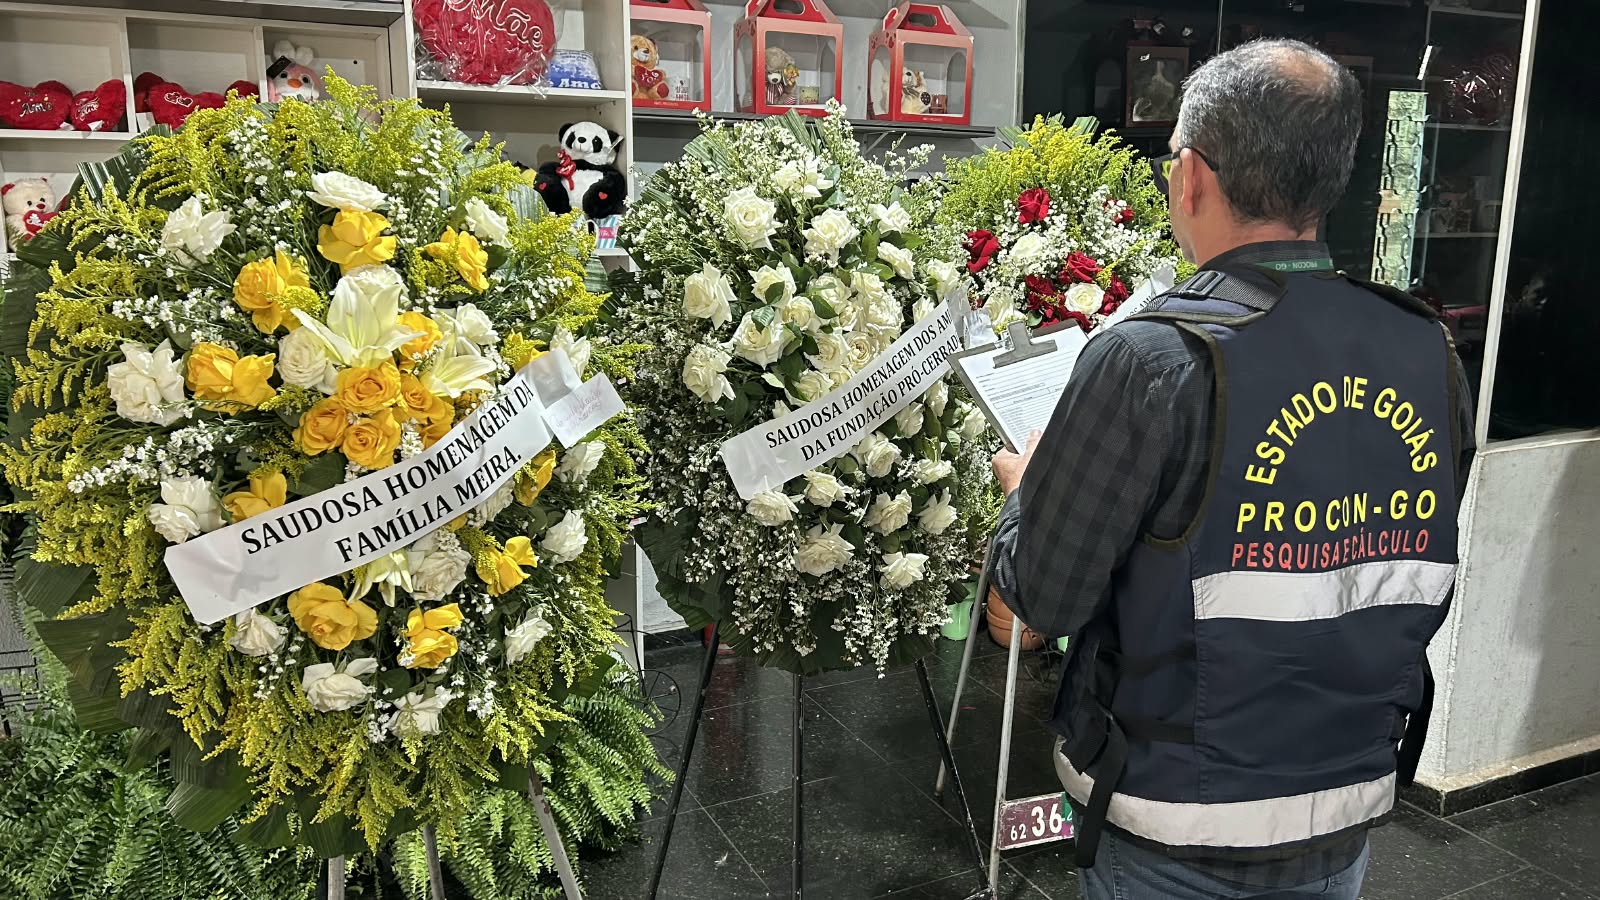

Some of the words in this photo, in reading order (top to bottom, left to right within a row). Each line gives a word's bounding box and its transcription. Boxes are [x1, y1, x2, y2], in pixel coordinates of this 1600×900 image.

[1275, 263, 1287, 271] GO
[1292, 261, 1318, 270] PROCON
[765, 401, 843, 449] SAUDOSA
[841, 342, 917, 411] HOMENAGEM
[913, 324, 937, 352] DOS
[800, 439, 827, 461] DA
[826, 388, 898, 448] FUNDAÇÃO
[1244, 380, 1338, 486] ESTADO
[1343, 375, 1369, 410] DE
[1373, 386, 1438, 474] GOIÁS
[241, 485, 384, 555] SAUDOSA
[382, 395, 518, 501] HOMENAGEM
[514, 379, 534, 409] DA
[334, 494, 454, 564] FAMÍLIA
[453, 445, 522, 507] MEIRA.
[1010, 823, 1027, 841] 62
